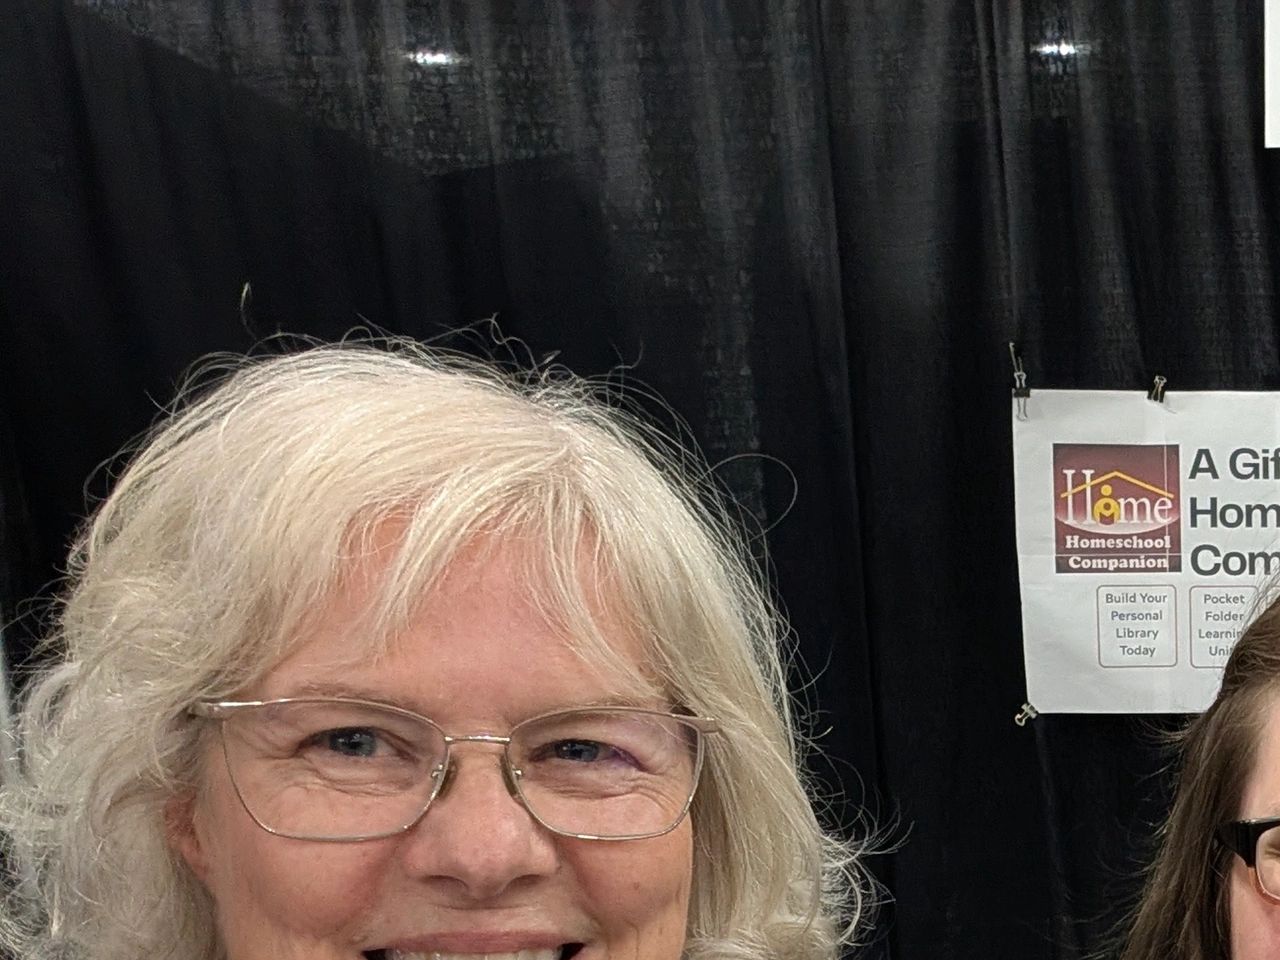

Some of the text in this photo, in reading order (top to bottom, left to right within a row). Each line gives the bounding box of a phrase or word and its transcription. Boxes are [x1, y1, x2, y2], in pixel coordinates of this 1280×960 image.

[1188, 448, 1219, 480] A
[1065, 535, 1171, 549] Homeschool
[1068, 556, 1169, 571] Companion
[1105, 593, 1168, 604] Build Your
[1203, 594, 1245, 605] Pocket
[1111, 610, 1162, 621] Personal
[1205, 611, 1244, 622] Folder
[1116, 628, 1159, 640] Library
[1199, 628, 1243, 639] Learnin
[1120, 645, 1156, 657] Today
